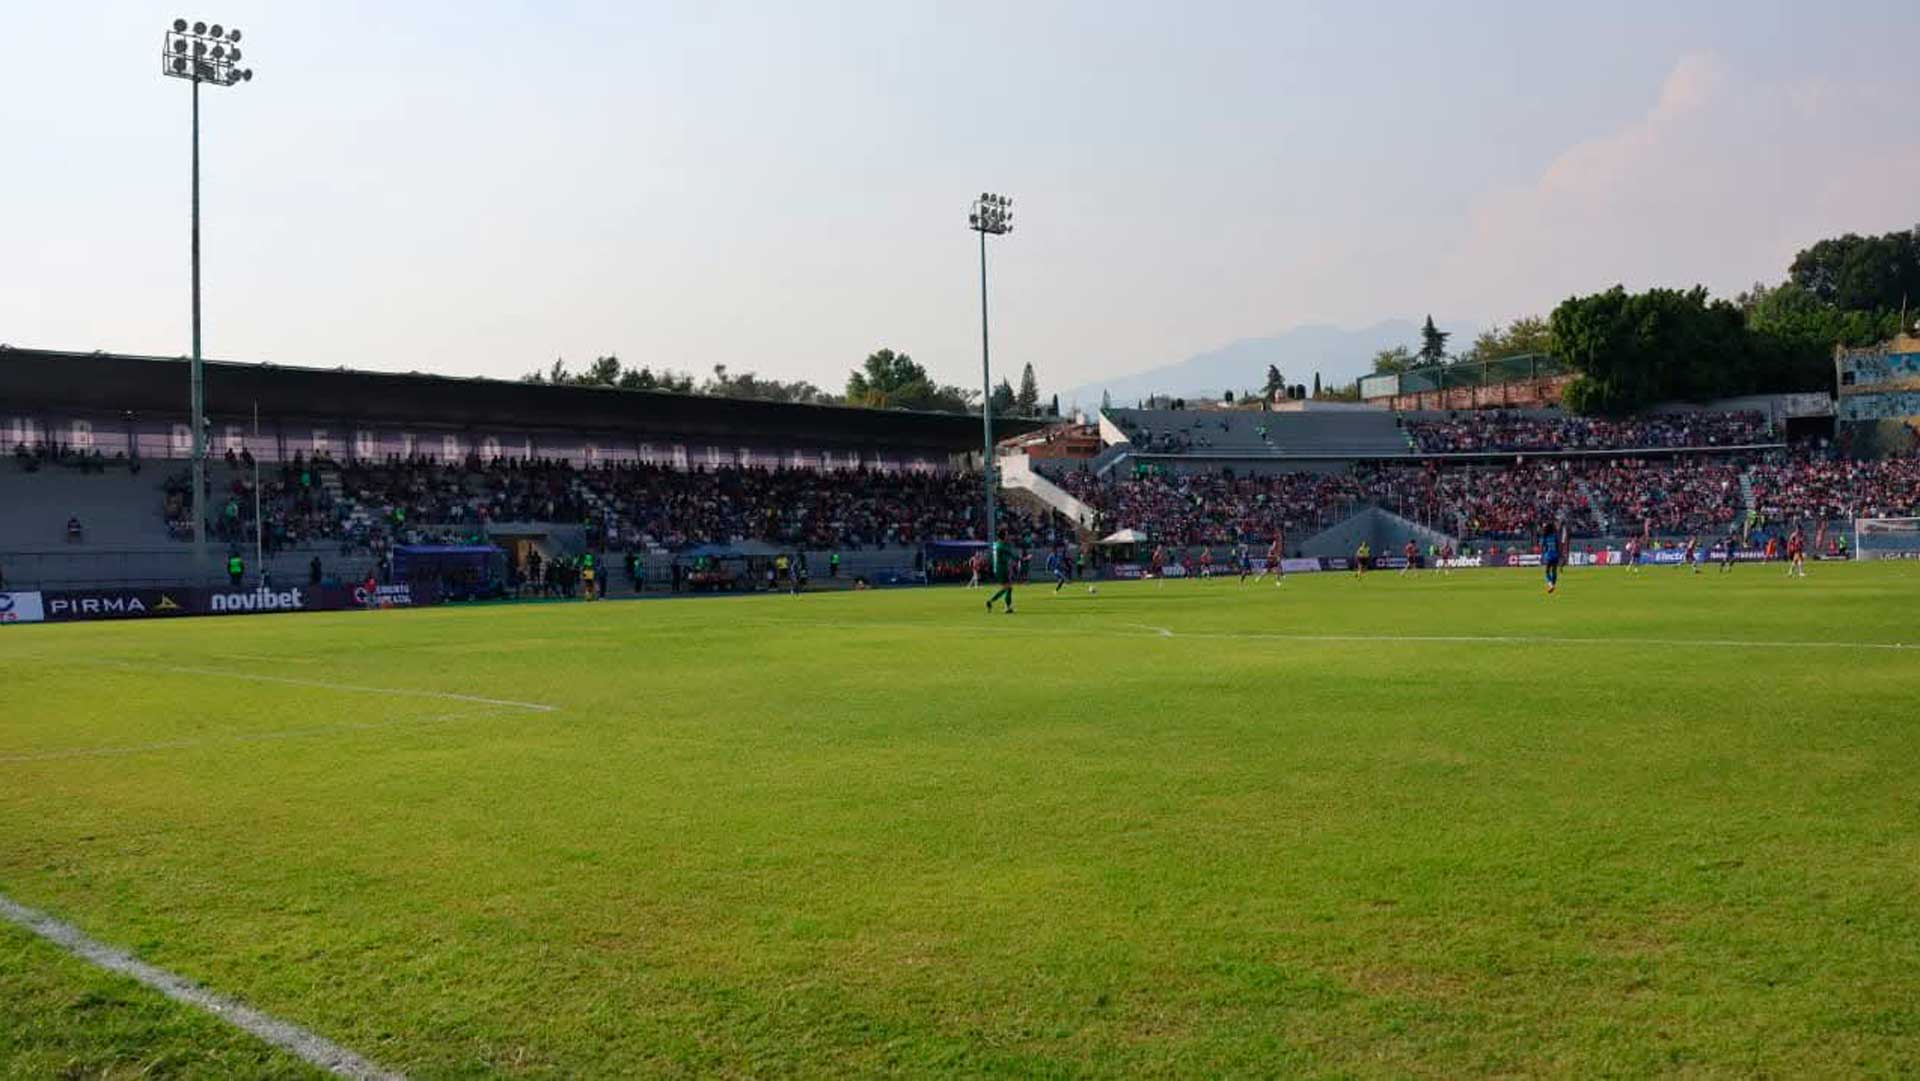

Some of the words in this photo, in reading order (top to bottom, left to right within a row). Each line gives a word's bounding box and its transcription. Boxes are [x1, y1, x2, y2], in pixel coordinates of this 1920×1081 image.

[1436, 555, 1482, 567] nvibet
[51, 596, 146, 613] PIRMA
[211, 587, 304, 611] novibet
